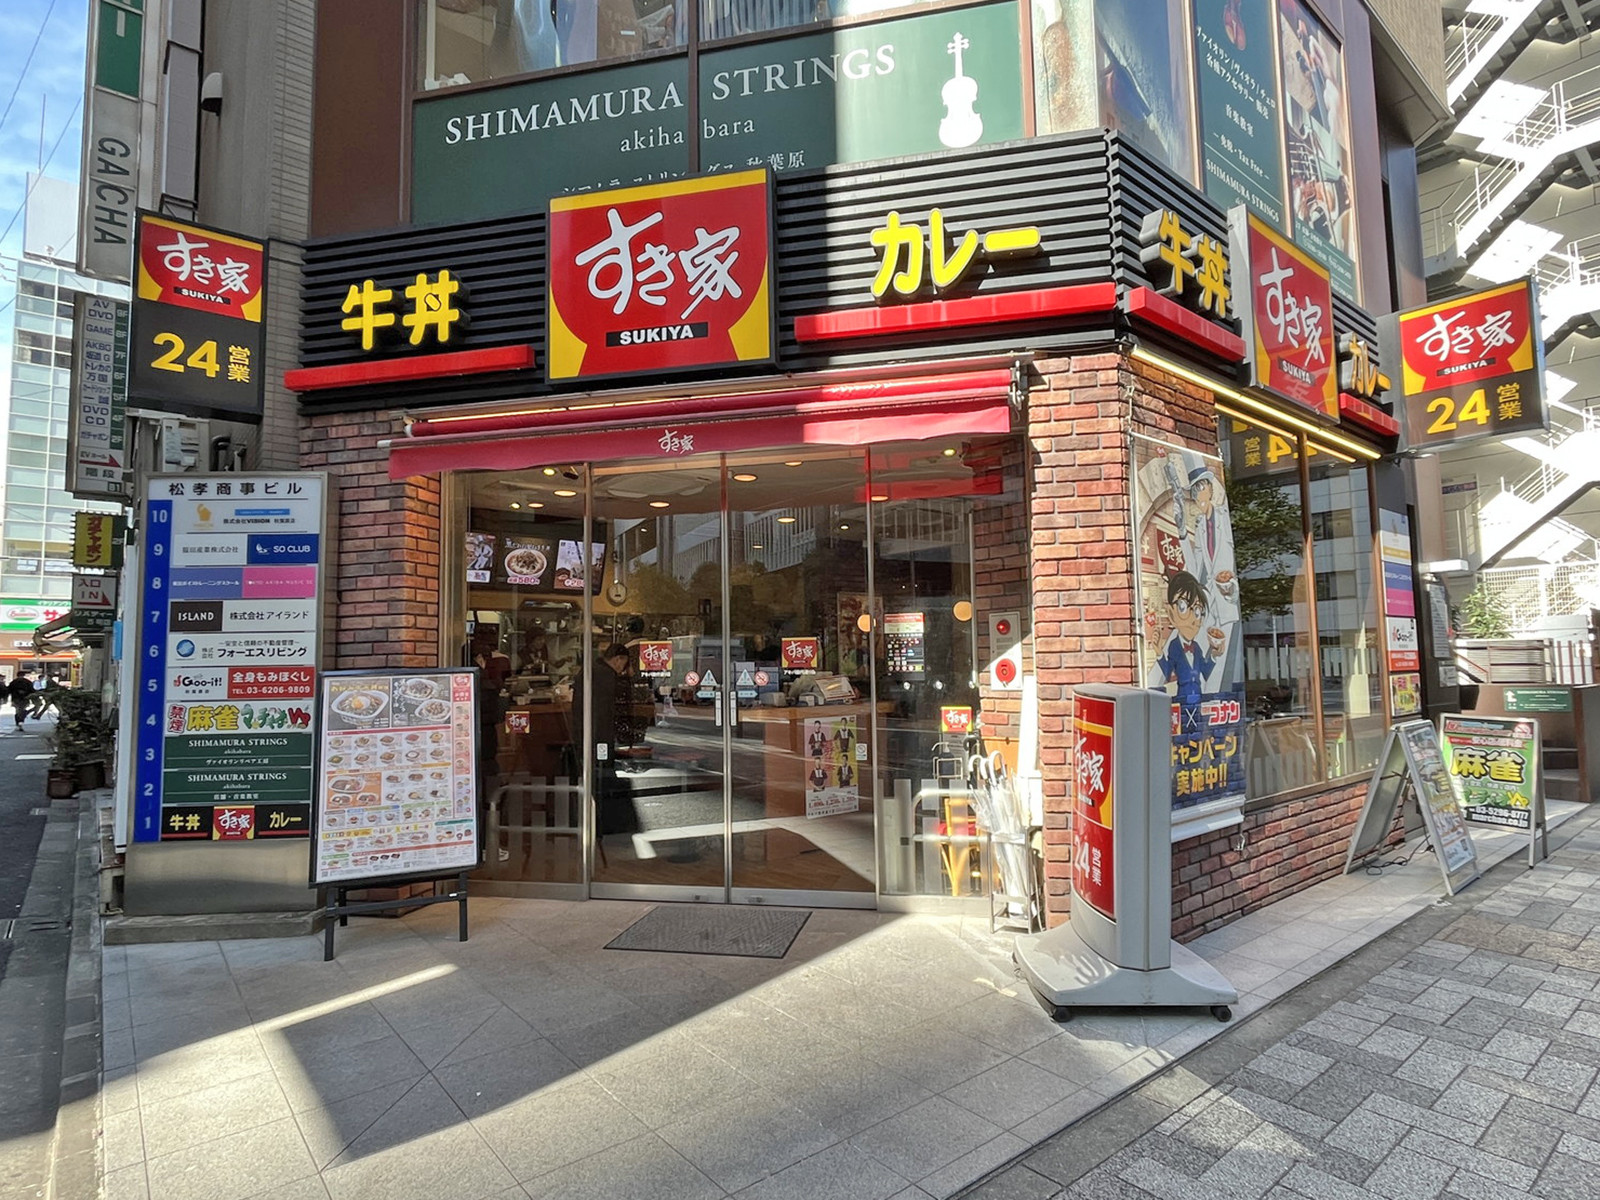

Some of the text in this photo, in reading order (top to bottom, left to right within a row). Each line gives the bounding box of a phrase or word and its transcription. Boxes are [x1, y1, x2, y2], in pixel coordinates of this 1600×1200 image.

[446, 43, 896, 146] SHIMAMURA STRINGS
[94, 137, 131, 244] GACHA
[1205, 158, 1279, 223] SHIMAMURA STRINGS
[869, 206, 1042, 298] カレー
[157, 232, 250, 294] すき家
[574, 207, 743, 320] すき家
[1157, 210, 1231, 319] 牛丼
[93, 299, 110, 309] AV
[181, 288, 225, 304] SUKIYA
[88, 309, 114, 320] DVD
[340, 268, 461, 351] 牛丼
[1259, 246, 1326, 366] すき家
[86, 323, 114, 337] GAME
[618, 325, 695, 345] SUKIYA
[1415, 309, 1516, 362] すき家
[150, 332, 250, 384] 24 営業
[1349, 332, 1392, 398] カレー
[1444, 359, 1488, 375] SUKIYA
[1281, 359, 1312, 385] SUKIYA
[82, 404, 110, 417] DVD
[1426, 382, 1522, 434] 24 営業
[85, 416, 106, 426] CD
[658, 429, 695, 455] すき家
[168, 482, 303, 496] 松孝商事ビル
[152, 509, 168, 523] 10
[153, 543, 164, 556] 9
[273, 544, 311, 553] SO CLUB
[1160, 532, 1185, 566] すき家
[78, 578, 101, 588] 入口
[152, 577, 162, 589] 8
[152, 611, 161, 623] 7
[178, 612, 215, 621] ISLAND
[149, 645, 159, 658] 6
[217, 647, 307, 658] フォーエスリビング
[643, 644, 669, 662] すき家
[786, 640, 814, 660] すき家
[147, 679, 158, 692] 5
[232, 671, 310, 683] 全身もみほぐし
[146, 714, 156, 726] 4
[186, 704, 240, 732] 麻雀
[508, 713, 528, 728] すき家
[945, 709, 969, 725] すき家
[1209, 701, 1240, 724] コナン
[188, 737, 288, 748] SHIMAMURA STRINGS
[145, 748, 155, 761] 3
[1074, 729, 1105, 796] すき家
[1450, 747, 1526, 784] 麻雀
[187, 772, 288, 782] SHIMAMURA STRINGS
[1175, 763, 1228, 797] 実施中!!
[144, 784, 153, 796] 2
[144, 816, 151, 830] 1
[169, 813, 201, 831] 牛丼
[218, 809, 251, 831] すき家
[269, 811, 302, 829] カレー
[1074, 836, 1102, 887] 24 営業
